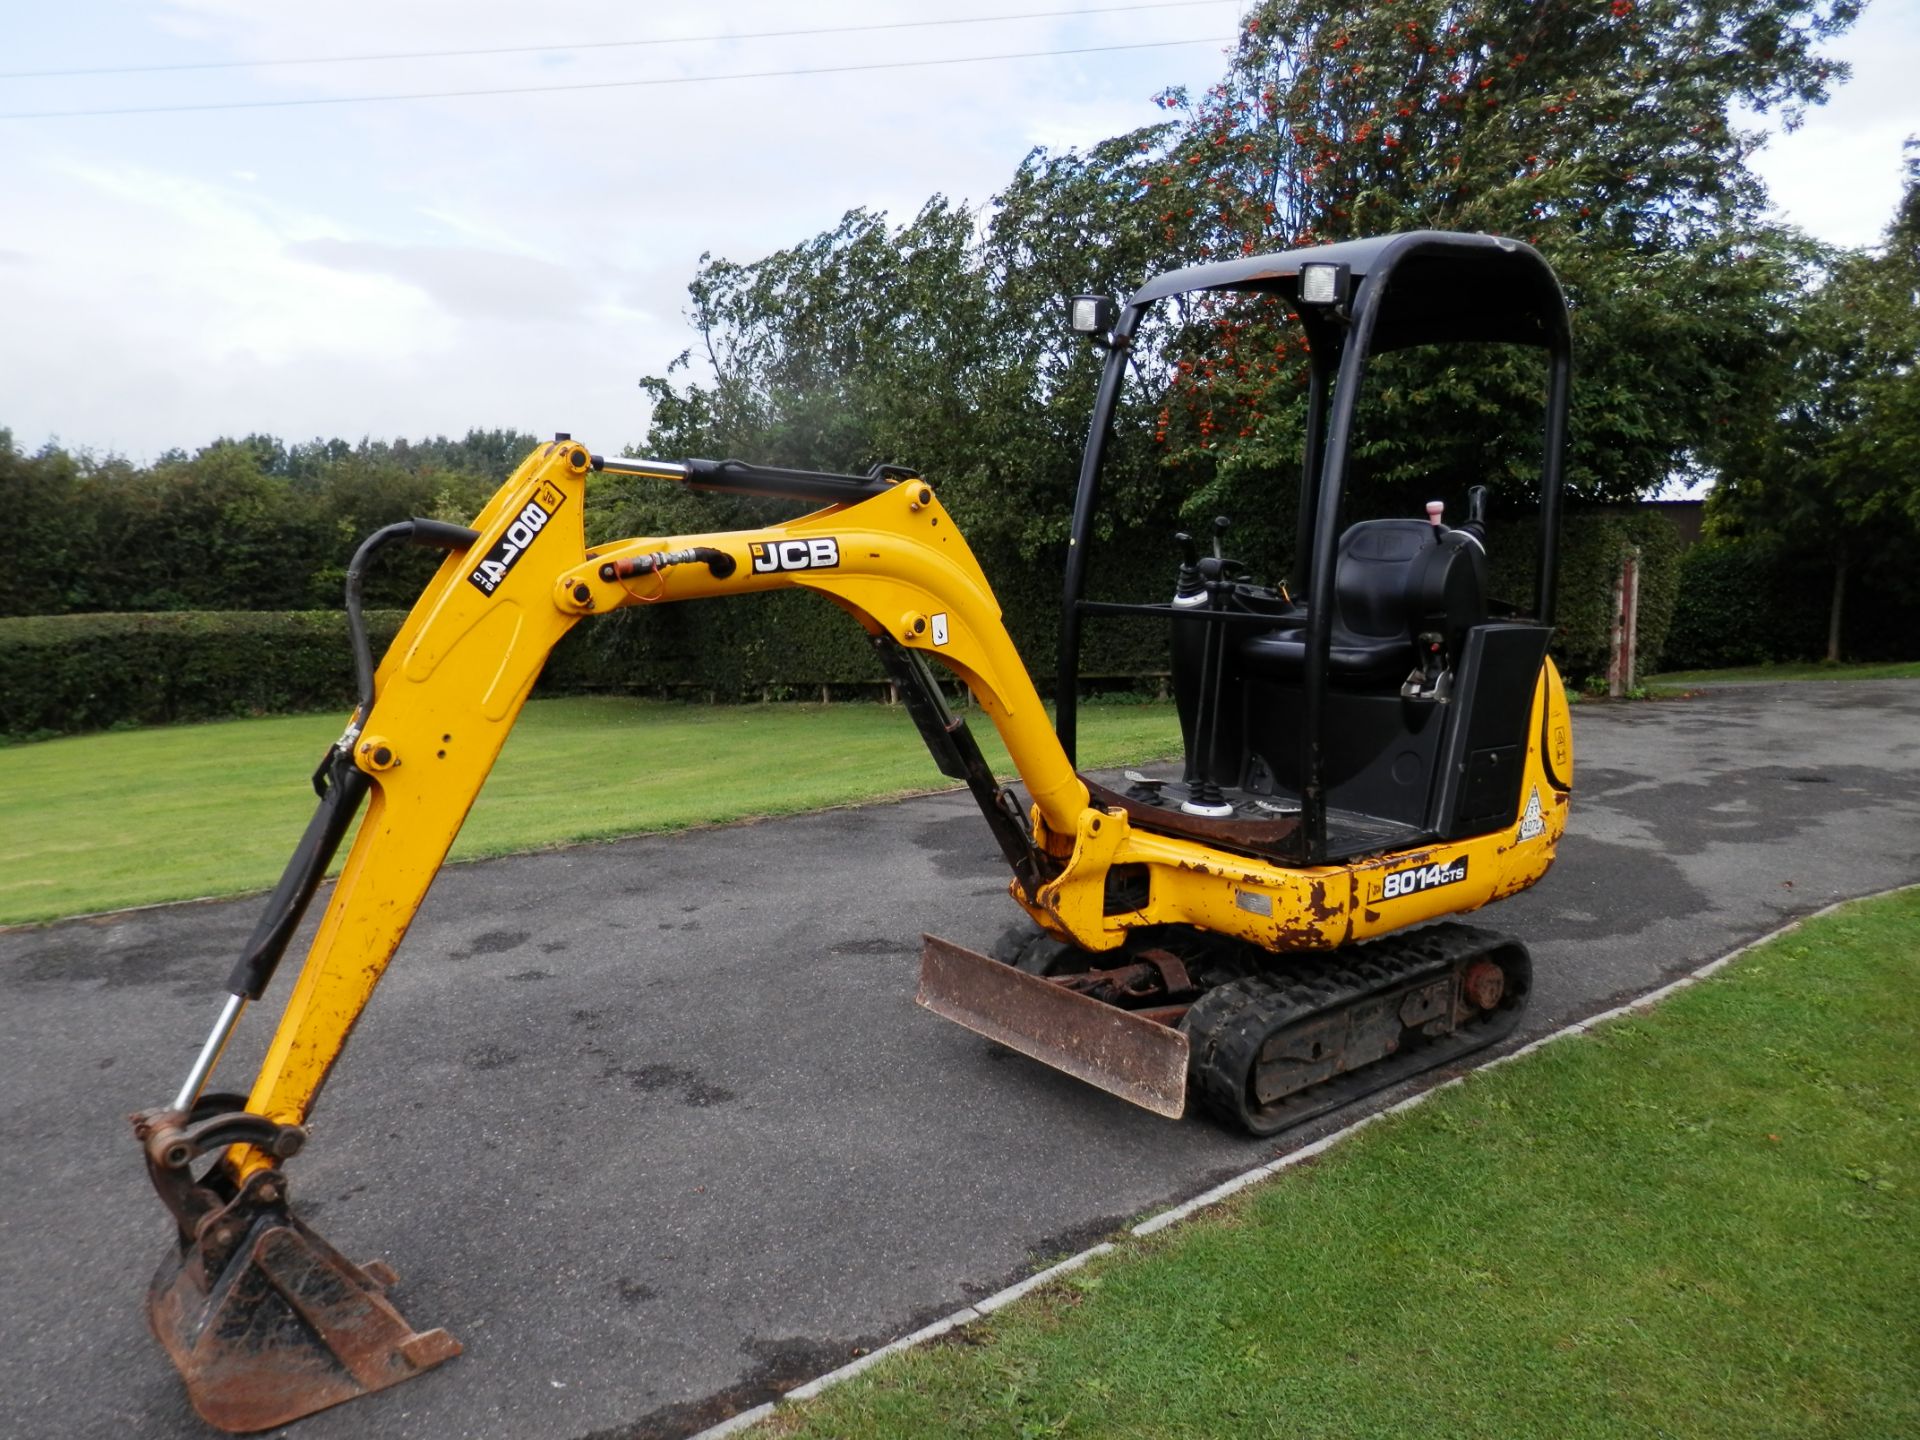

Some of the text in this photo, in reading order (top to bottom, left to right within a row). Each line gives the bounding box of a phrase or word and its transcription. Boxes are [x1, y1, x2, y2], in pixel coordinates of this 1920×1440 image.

[480, 503, 548, 584] 8014
[755, 539, 838, 572] JCB
[473, 572, 494, 591] CTS
